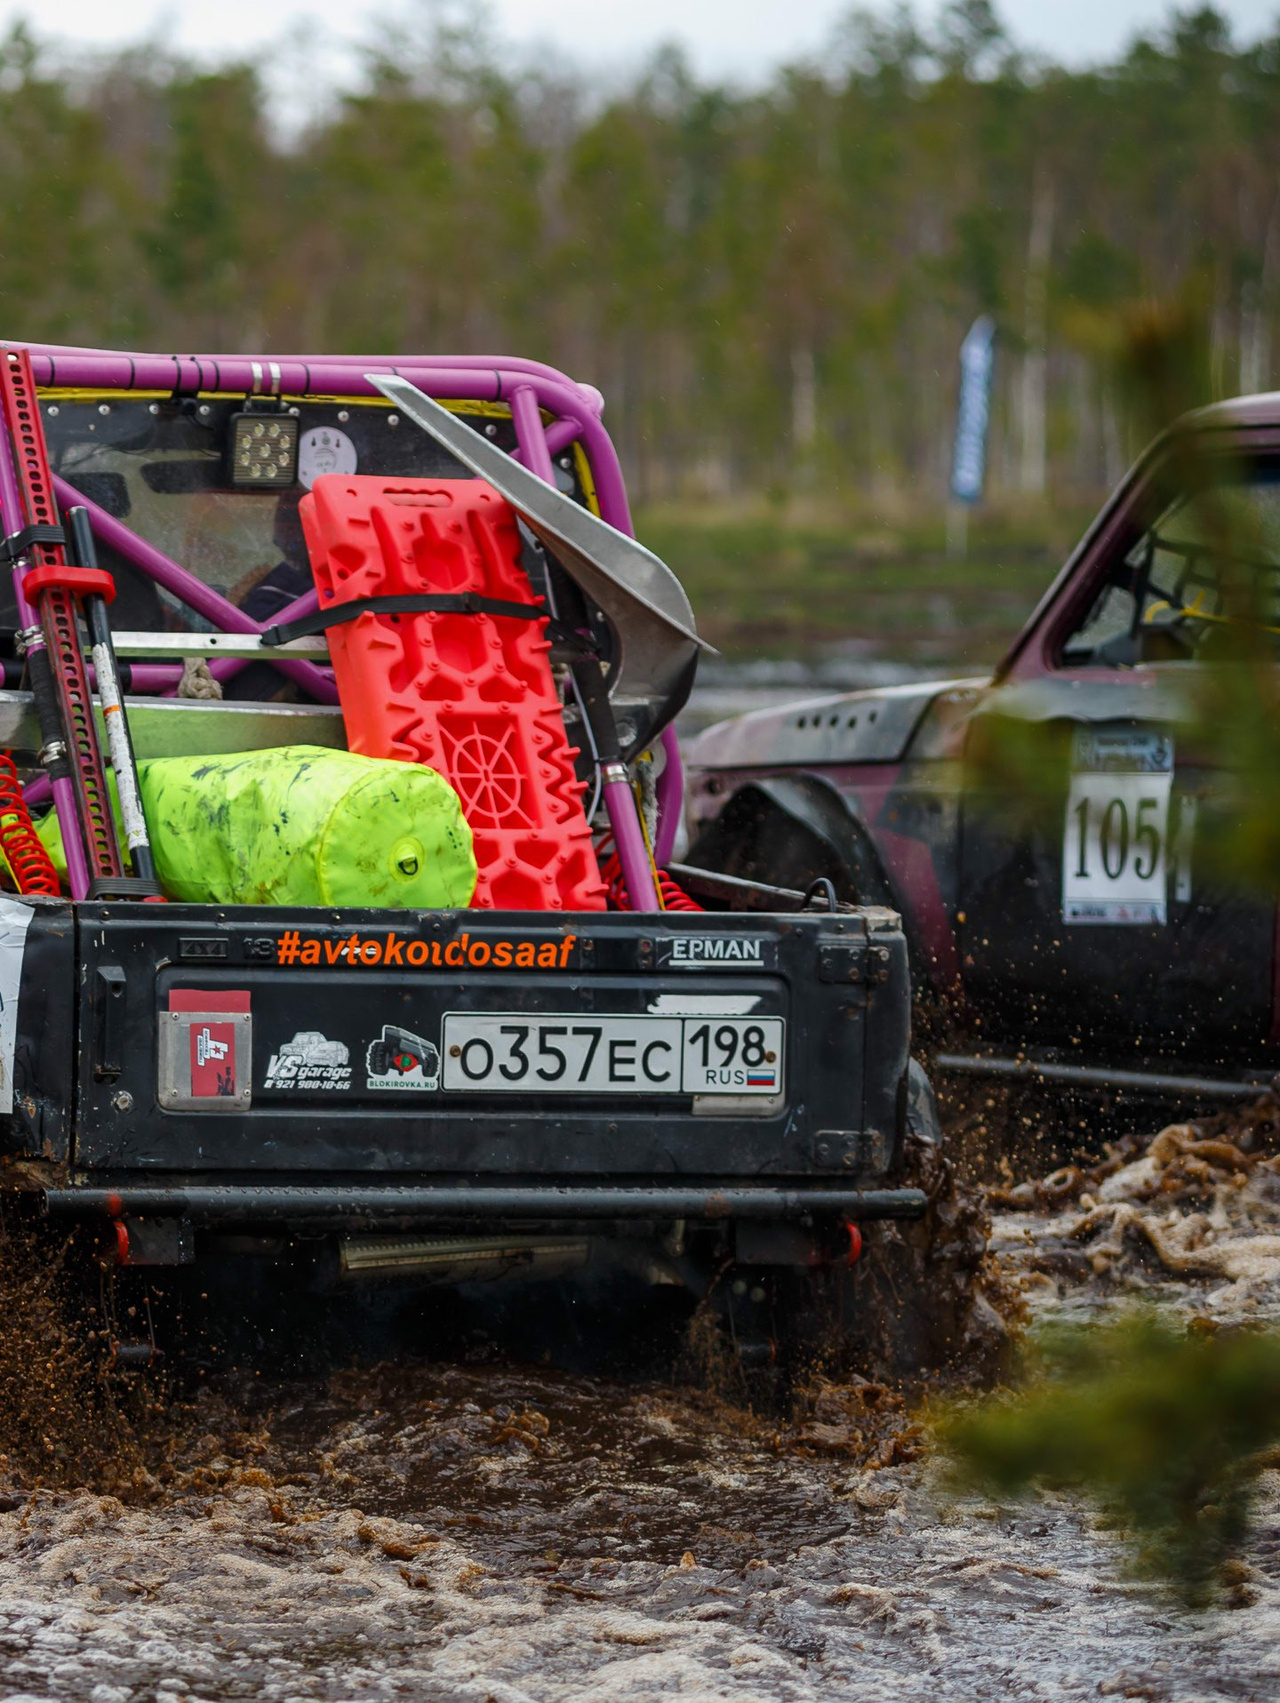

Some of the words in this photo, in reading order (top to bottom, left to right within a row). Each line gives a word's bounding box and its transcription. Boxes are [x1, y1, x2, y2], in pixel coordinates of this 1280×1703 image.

[1075, 797, 1161, 880] 105
[672, 939, 760, 959] EPMAN
[688, 1024, 765, 1068] 198
[266, 1055, 299, 1078] VS
[297, 1066, 352, 1081] garage
[706, 1069, 745, 1086] RUS
[276, 1080, 296, 1089] 921
[369, 1080, 436, 1088] BLOKIROVKA.RU
